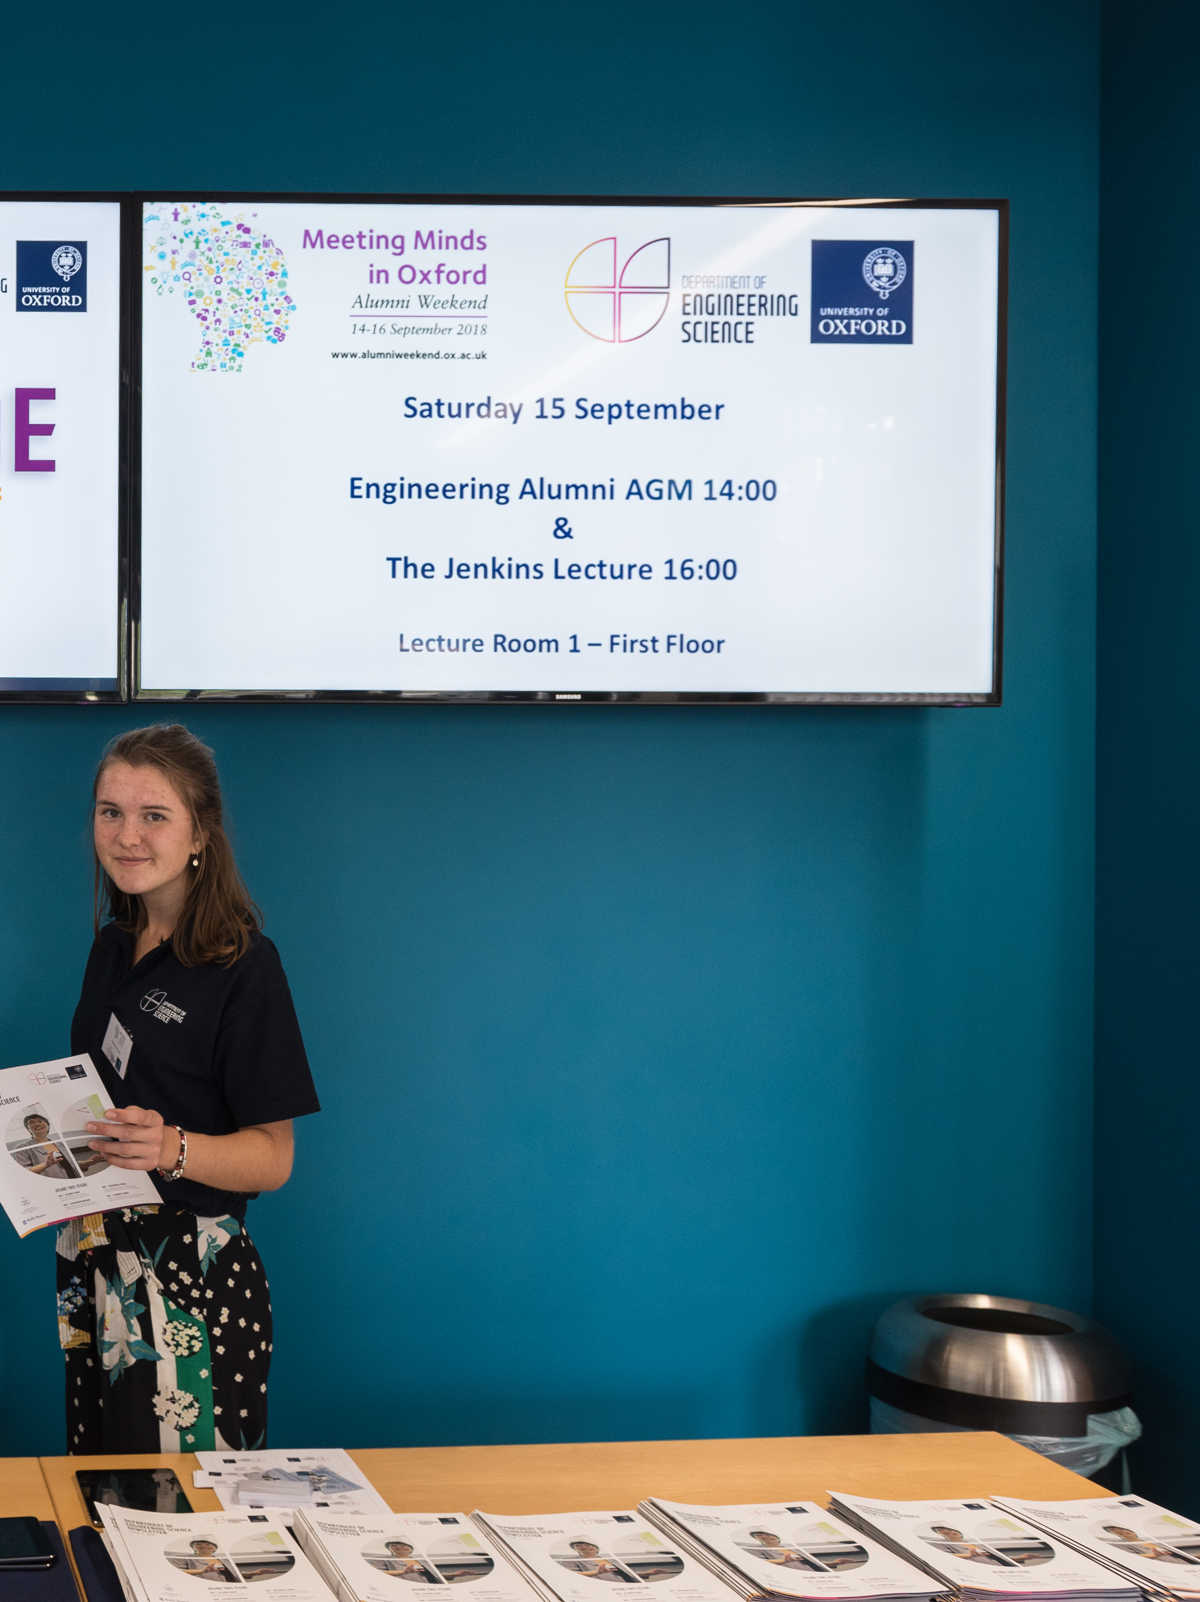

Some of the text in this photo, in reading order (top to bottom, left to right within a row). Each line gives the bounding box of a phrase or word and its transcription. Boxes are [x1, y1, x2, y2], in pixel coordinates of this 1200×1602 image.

[303, 229, 487, 256] Meeting Minds
[369, 263, 486, 285] in Oxford
[680, 272, 768, 290] DEPARTMENT OF
[22, 295, 82, 306] OXFORD
[352, 294, 488, 309] Alumni Weekend
[682, 294, 798, 316] ENGINEERING
[820, 307, 889, 316] UNIVERSITY OF
[352, 323, 487, 338] 14-16 September 2018
[682, 321, 754, 343] SCIENCE
[818, 319, 906, 335] OXFORD
[331, 350, 487, 359] www.alumniweekend.ox.ac.uk
[404, 396, 725, 425] Saturday 15 September
[350, 477, 777, 505] Engineering Alumni AGM 14:00
[553, 517, 573, 539] &
[386, 556, 737, 580] The Jenkins Lecture 16:00
[400, 633, 484, 652] Lecture
[494, 634, 559, 653] Room
[569, 634, 580, 653] 1
[610, 634, 659, 653] First
[667, 634, 725, 653] Floor
